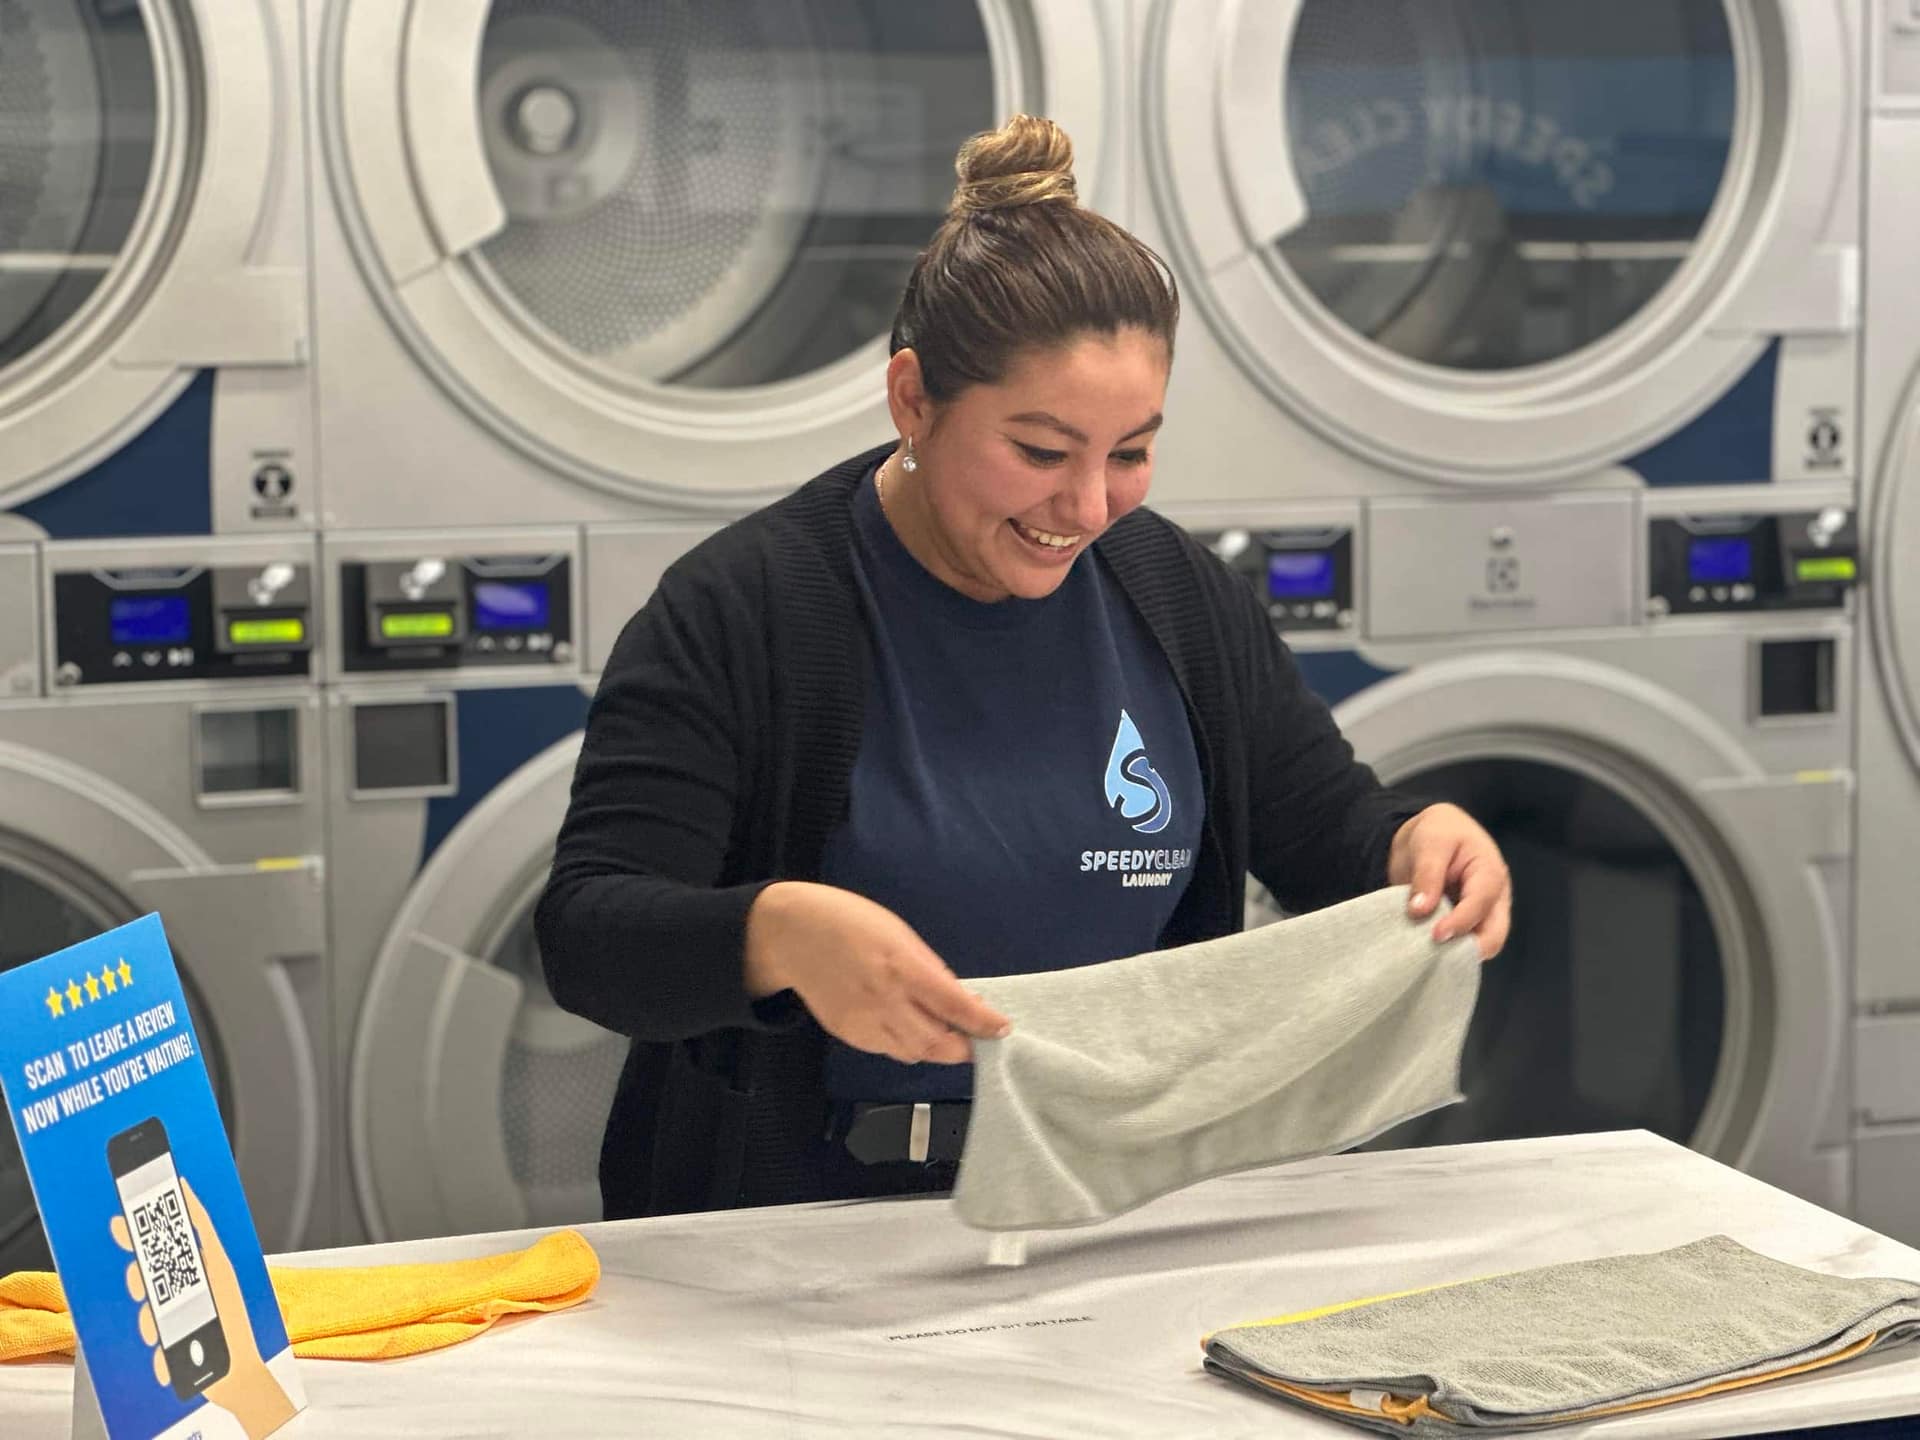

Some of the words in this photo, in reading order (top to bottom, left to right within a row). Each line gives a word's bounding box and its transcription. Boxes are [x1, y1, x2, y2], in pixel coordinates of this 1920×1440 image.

[1122, 872, 1172, 887] LAUNDRY
[24, 1051, 67, 1090] SCAN
[67, 1041, 89, 1071] TO
[88, 1024, 128, 1062] LEAVE
[126, 1020, 138, 1045] A
[135, 1001, 176, 1040] REVIEW
[22, 1096, 60, 1134] NOW
[58, 1076, 104, 1117] WHILE
[101, 1056, 148, 1097] YOU'RE
[144, 1032, 195, 1076] WAITING!
[889, 1330, 942, 1341] PLEASE
[969, 1325, 997, 1333] NOT
[1025, 1319, 1047, 1328] ON
[1047, 1315, 1096, 1324] TABLE
